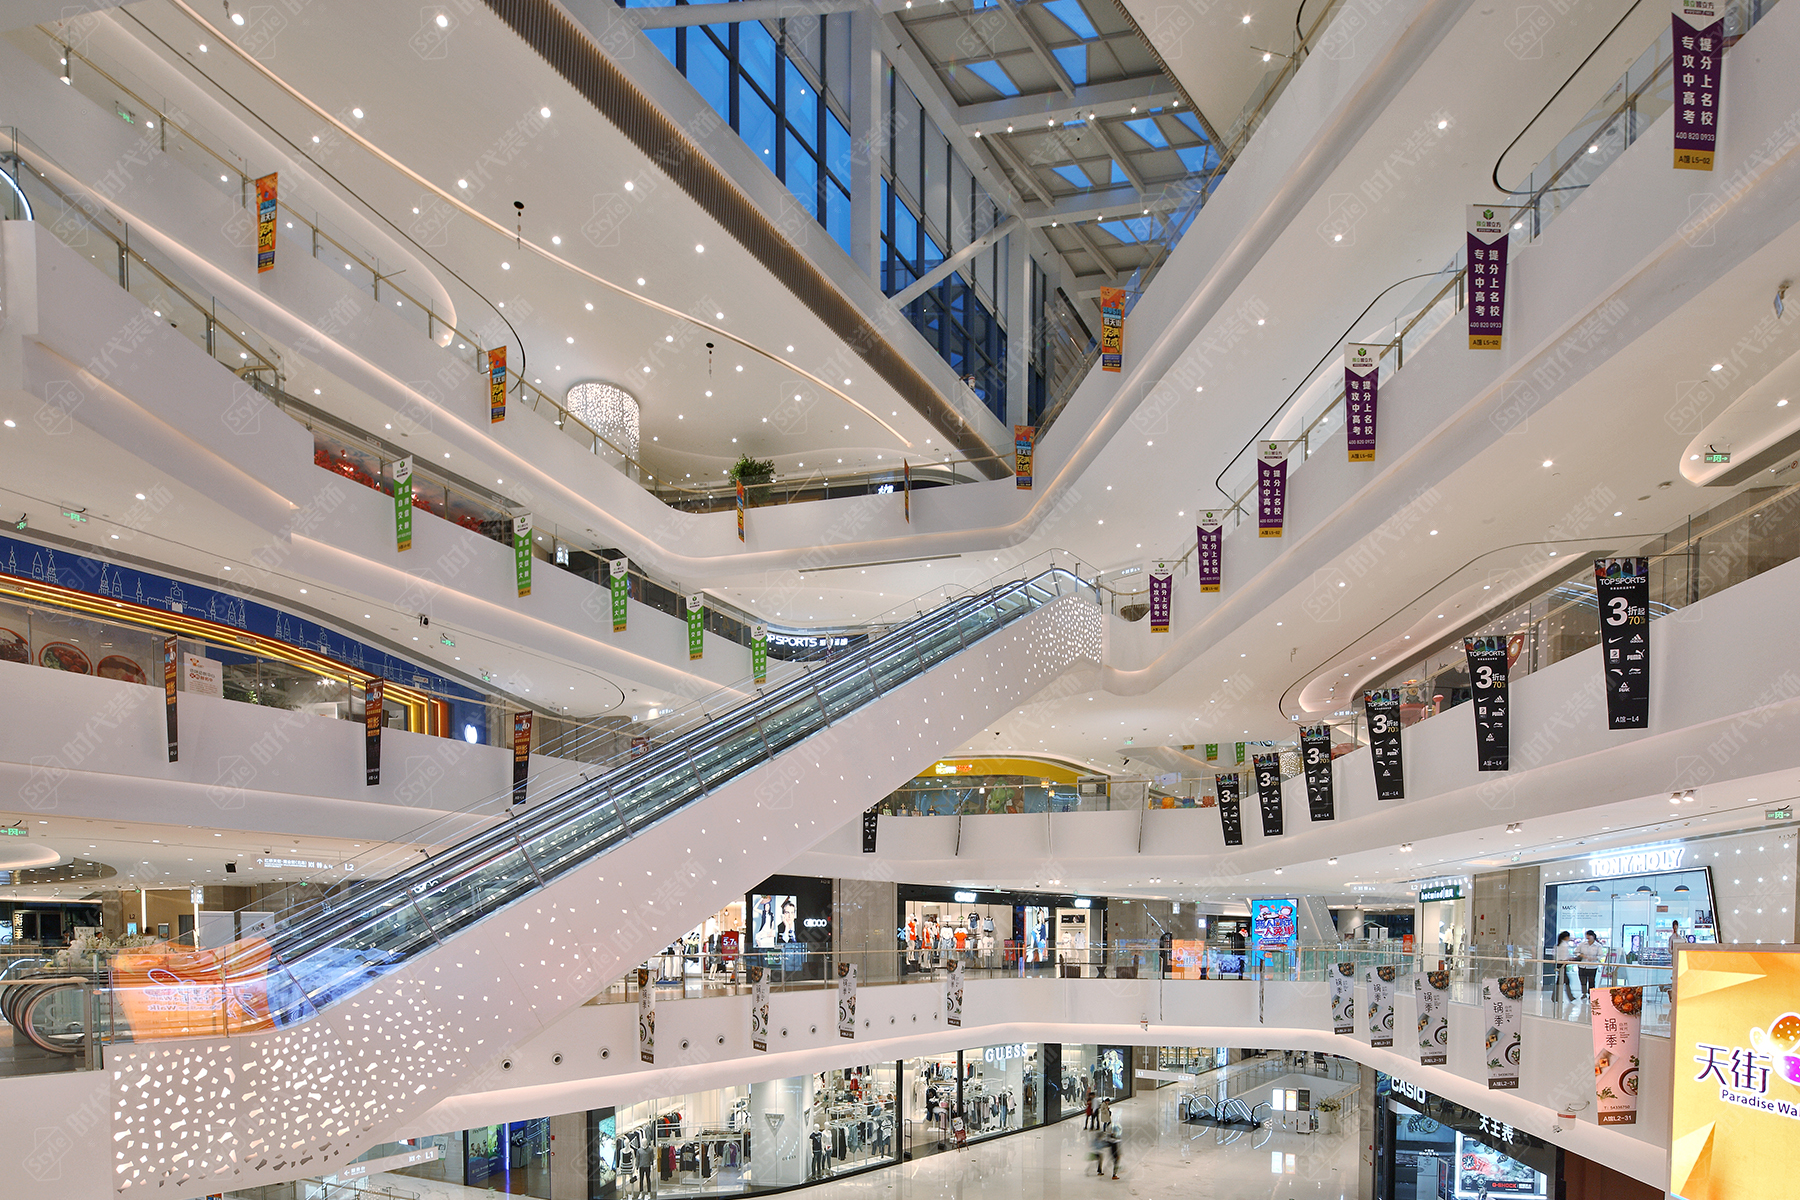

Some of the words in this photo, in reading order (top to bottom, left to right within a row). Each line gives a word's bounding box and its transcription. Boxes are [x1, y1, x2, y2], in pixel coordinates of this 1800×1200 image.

[1682, 36, 1695, 125] 专攻中高考
[1700, 37, 1713, 125] 提分上名校
[1676, 132, 1687, 140] 400
[1700, 133, 1715, 141] 0933
[1474, 249, 1485, 316] 专攻中高考
[1489, 250, 1500, 317] 提分上名校
[1351, 381, 1361, 435] 专攻中高考
[1363, 381, 1373, 435] 提分上名校
[1599, 576, 1646, 586] TOPSPORTS
[1606, 596, 1628, 626] 3
[1475, 666, 1493, 689] 3
[1372, 714, 1387, 734] 3
[1307, 748, 1320, 764] 3
[1260, 772, 1271, 787] 3
[1221, 790, 1231, 802] 3
[344, 863, 355, 871] L2
[1589, 848, 1685, 877] TONYMOLY
[1493, 1002, 1504, 1026] 锅季
[1605, 1018, 1617, 1048] 锅季
[985, 1043, 1028, 1062] GUESS
[1695, 1043, 1770, 1094] 天街
[1391, 1076, 1426, 1104] CASIO
[1721, 1089, 1774, 1111] Paradise
[1479, 1113, 1514, 1145] 天王表
[424, 1151, 434, 1160] L1
